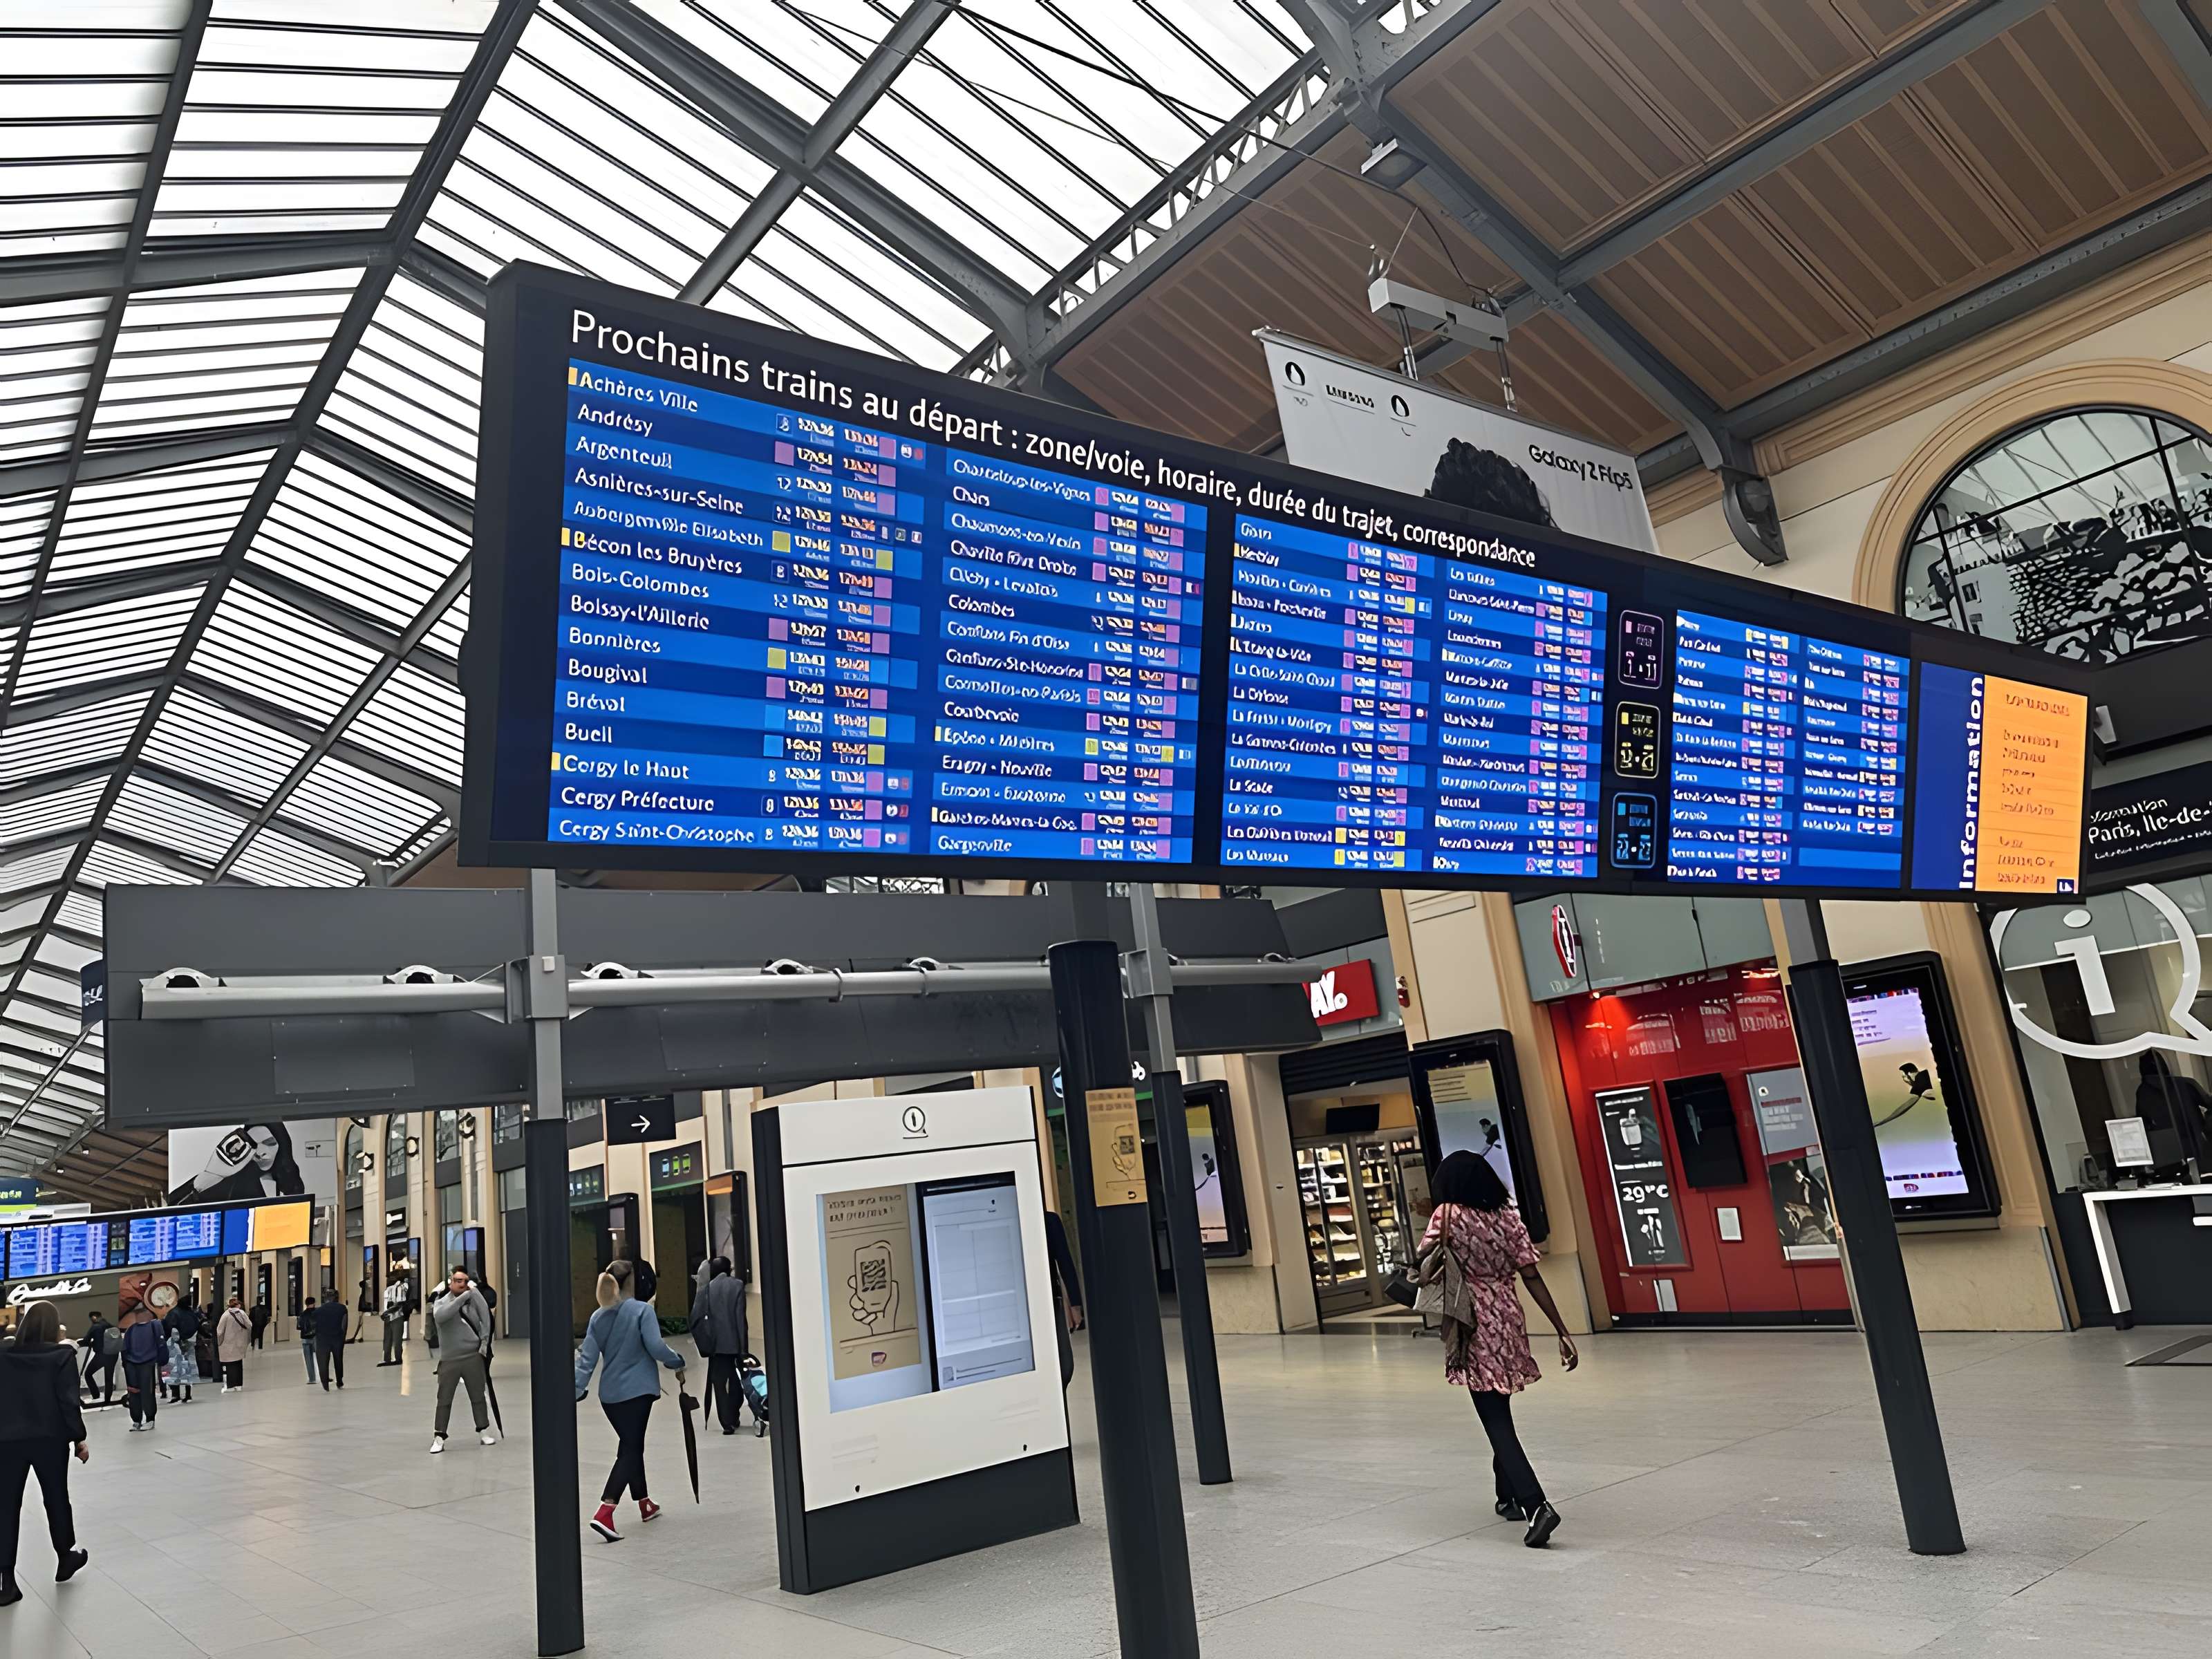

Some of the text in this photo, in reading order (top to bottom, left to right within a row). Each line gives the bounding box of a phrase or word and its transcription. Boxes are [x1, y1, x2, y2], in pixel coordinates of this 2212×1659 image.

[572, 309, 750, 383] Prochains
[761, 362, 852, 409] trains
[863, 392, 898, 421] au
[910, 398, 1002, 445] départ
[1026, 432, 1150, 486] zone/voie,
[1159, 458, 1242, 506] horaire,
[1248, 482, 1306, 517] durée
[1313, 497, 1336, 524] du
[1343, 505, 1398, 541] trajet,
[1403, 521, 1536, 568] correspondance
[1959, 677, 1983, 888] Information
[2143, 800, 2212, 832] Ile-de-
